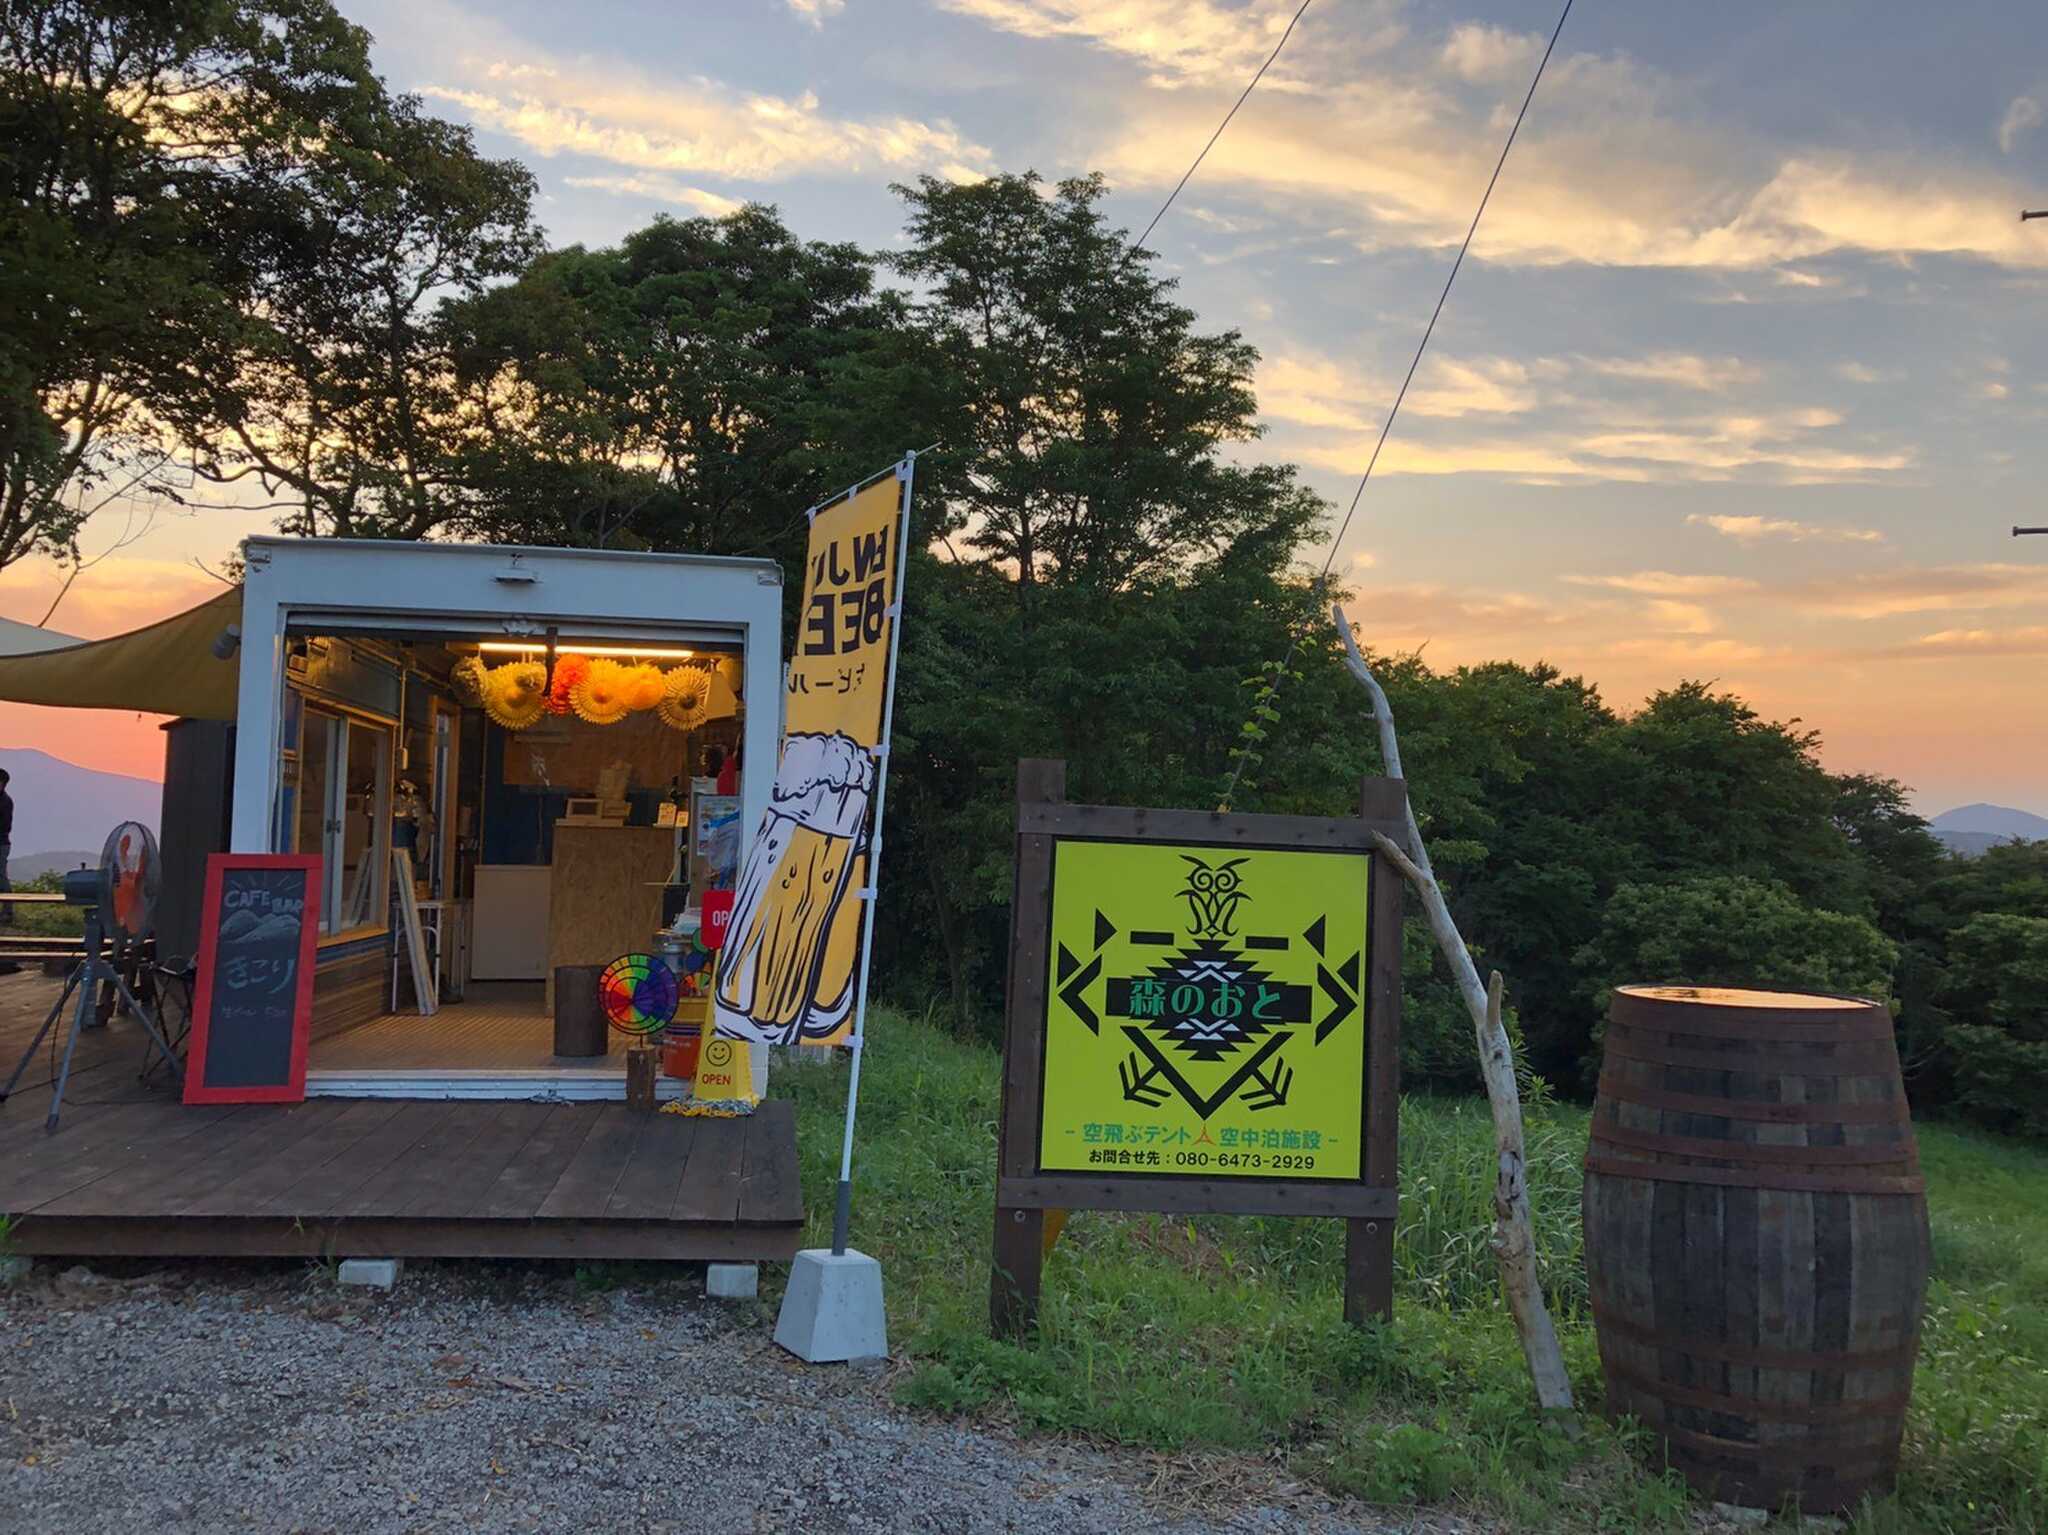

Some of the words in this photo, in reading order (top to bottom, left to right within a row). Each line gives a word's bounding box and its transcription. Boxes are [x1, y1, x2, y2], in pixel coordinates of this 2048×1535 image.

[224, 889, 270, 908] CAFE
[1129, 978, 1282, 1019] 森のおと
[702, 1074, 732, 1085] OPEN
[1083, 1122, 1191, 1146] 空飛ぶテント
[1219, 1127, 1323, 1150] 空中泊施設
[1176, 1151, 1315, 1169] 080-6473-2929
